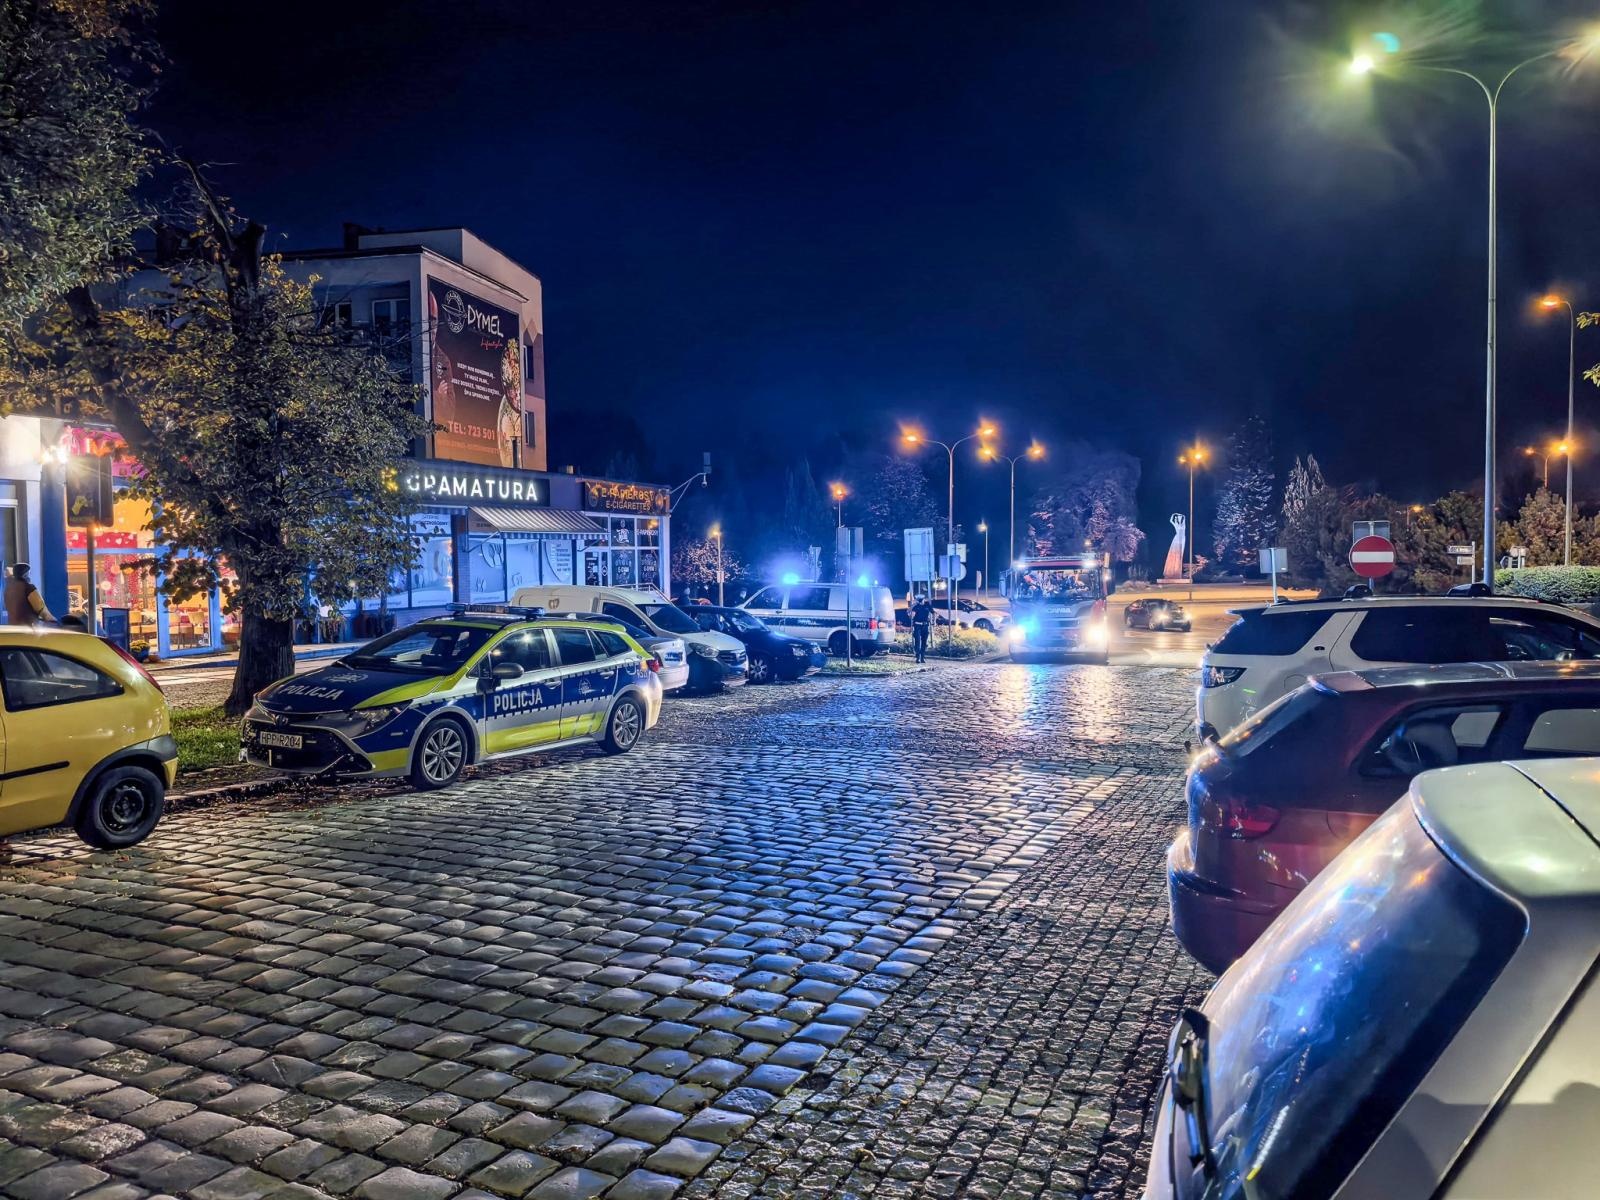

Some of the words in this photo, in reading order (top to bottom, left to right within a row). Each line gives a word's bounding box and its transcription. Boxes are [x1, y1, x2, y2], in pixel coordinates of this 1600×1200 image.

[448, 420, 466, 435] TEL:
[467, 424, 481, 438] 723
[482, 427, 495, 441] 501
[406, 474, 538, 501] GRAMATURA
[605, 500, 651, 511] E-CIGARETTES
[278, 685, 345, 700] POLICJA
[493, 687, 544, 713] POLICJA
[261, 733, 278, 746] HPP
